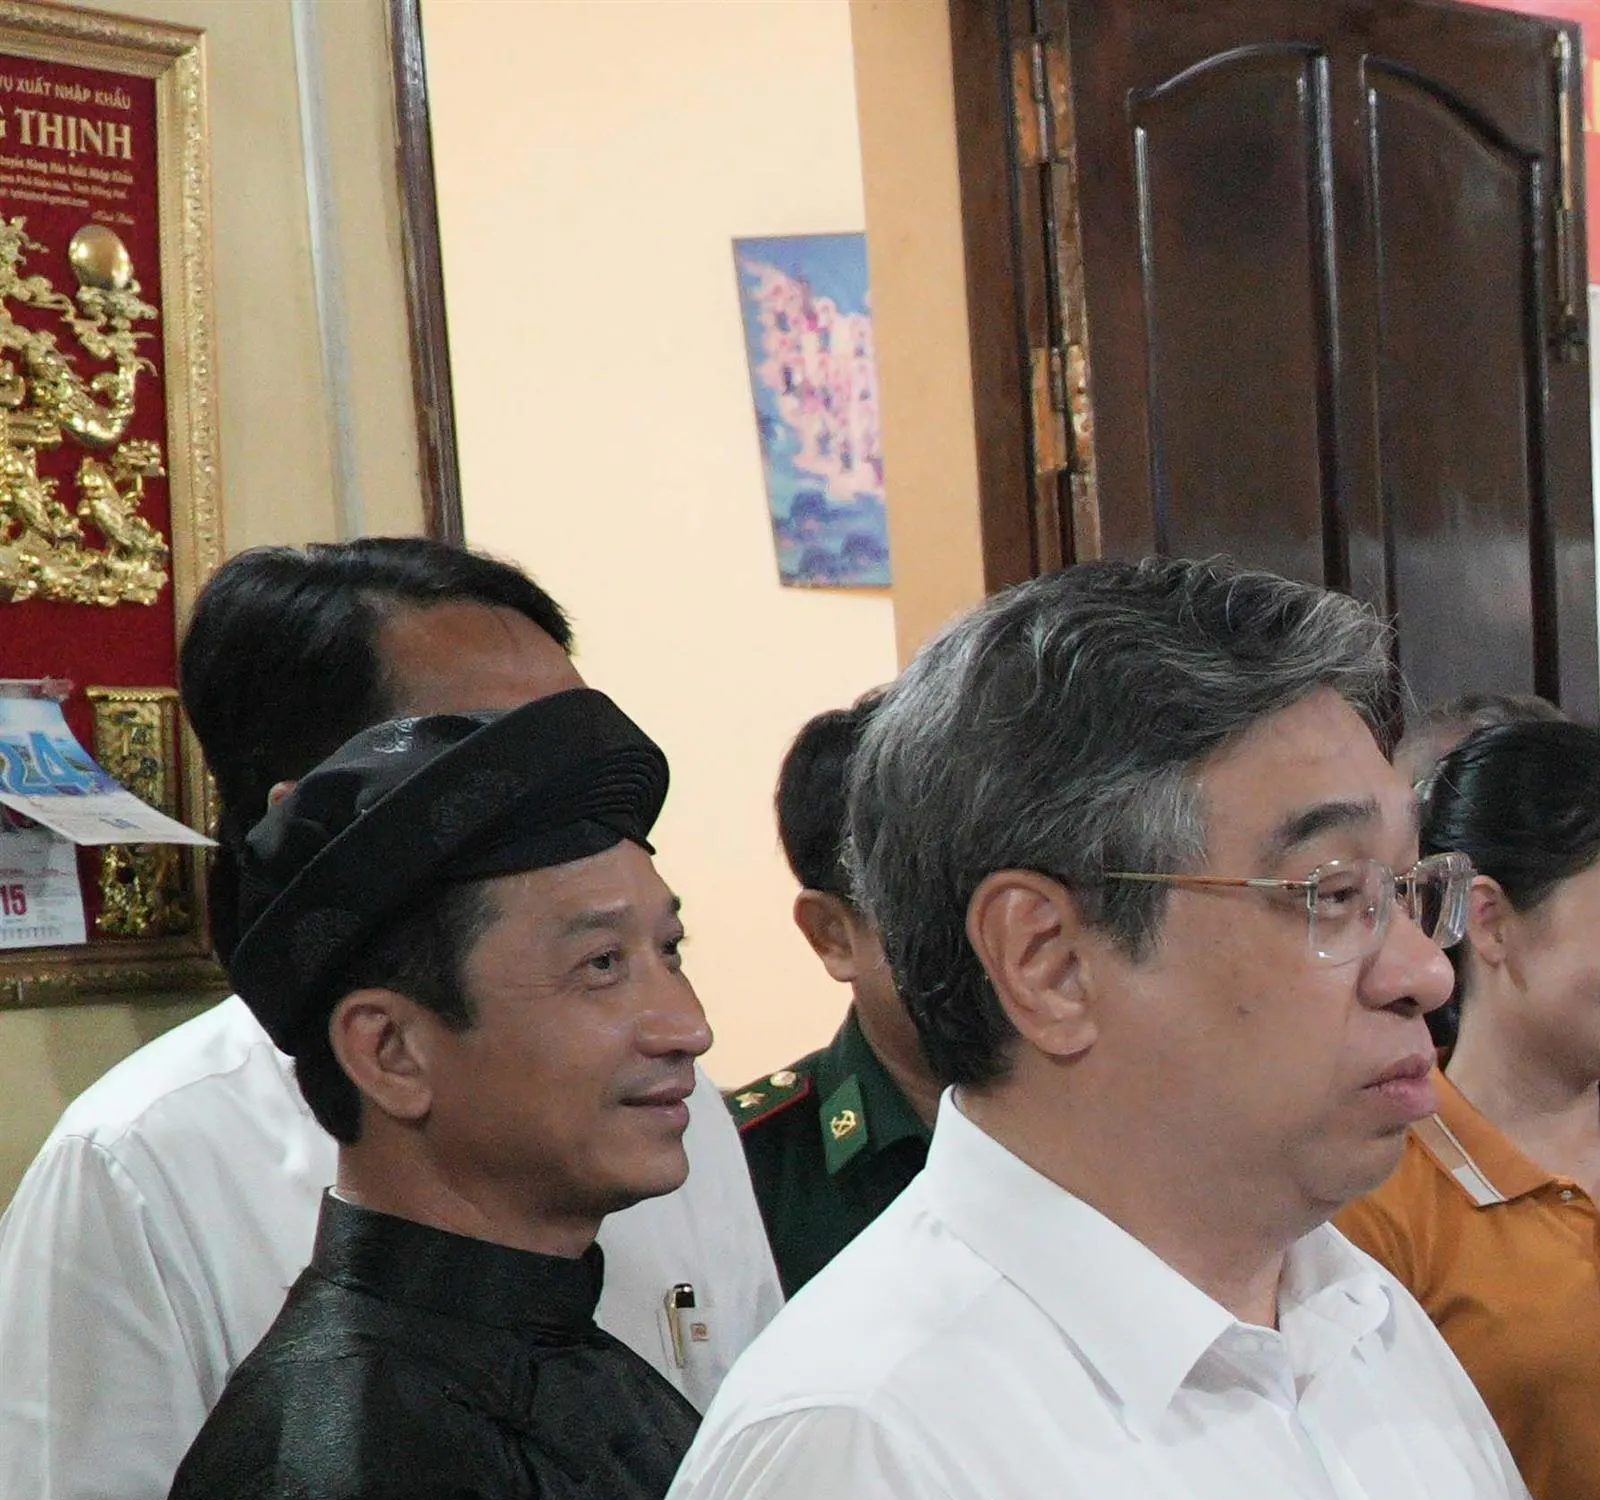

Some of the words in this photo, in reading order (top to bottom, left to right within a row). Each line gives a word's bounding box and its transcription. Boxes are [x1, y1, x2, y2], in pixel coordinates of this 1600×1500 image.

[16, 76, 50, 96] XUẤT
[55, 83, 92, 103] NHẬP
[95, 87, 132, 111] KHẨU
[14, 105, 133, 160] THỊNH
[0, 883, 28, 916] 15
